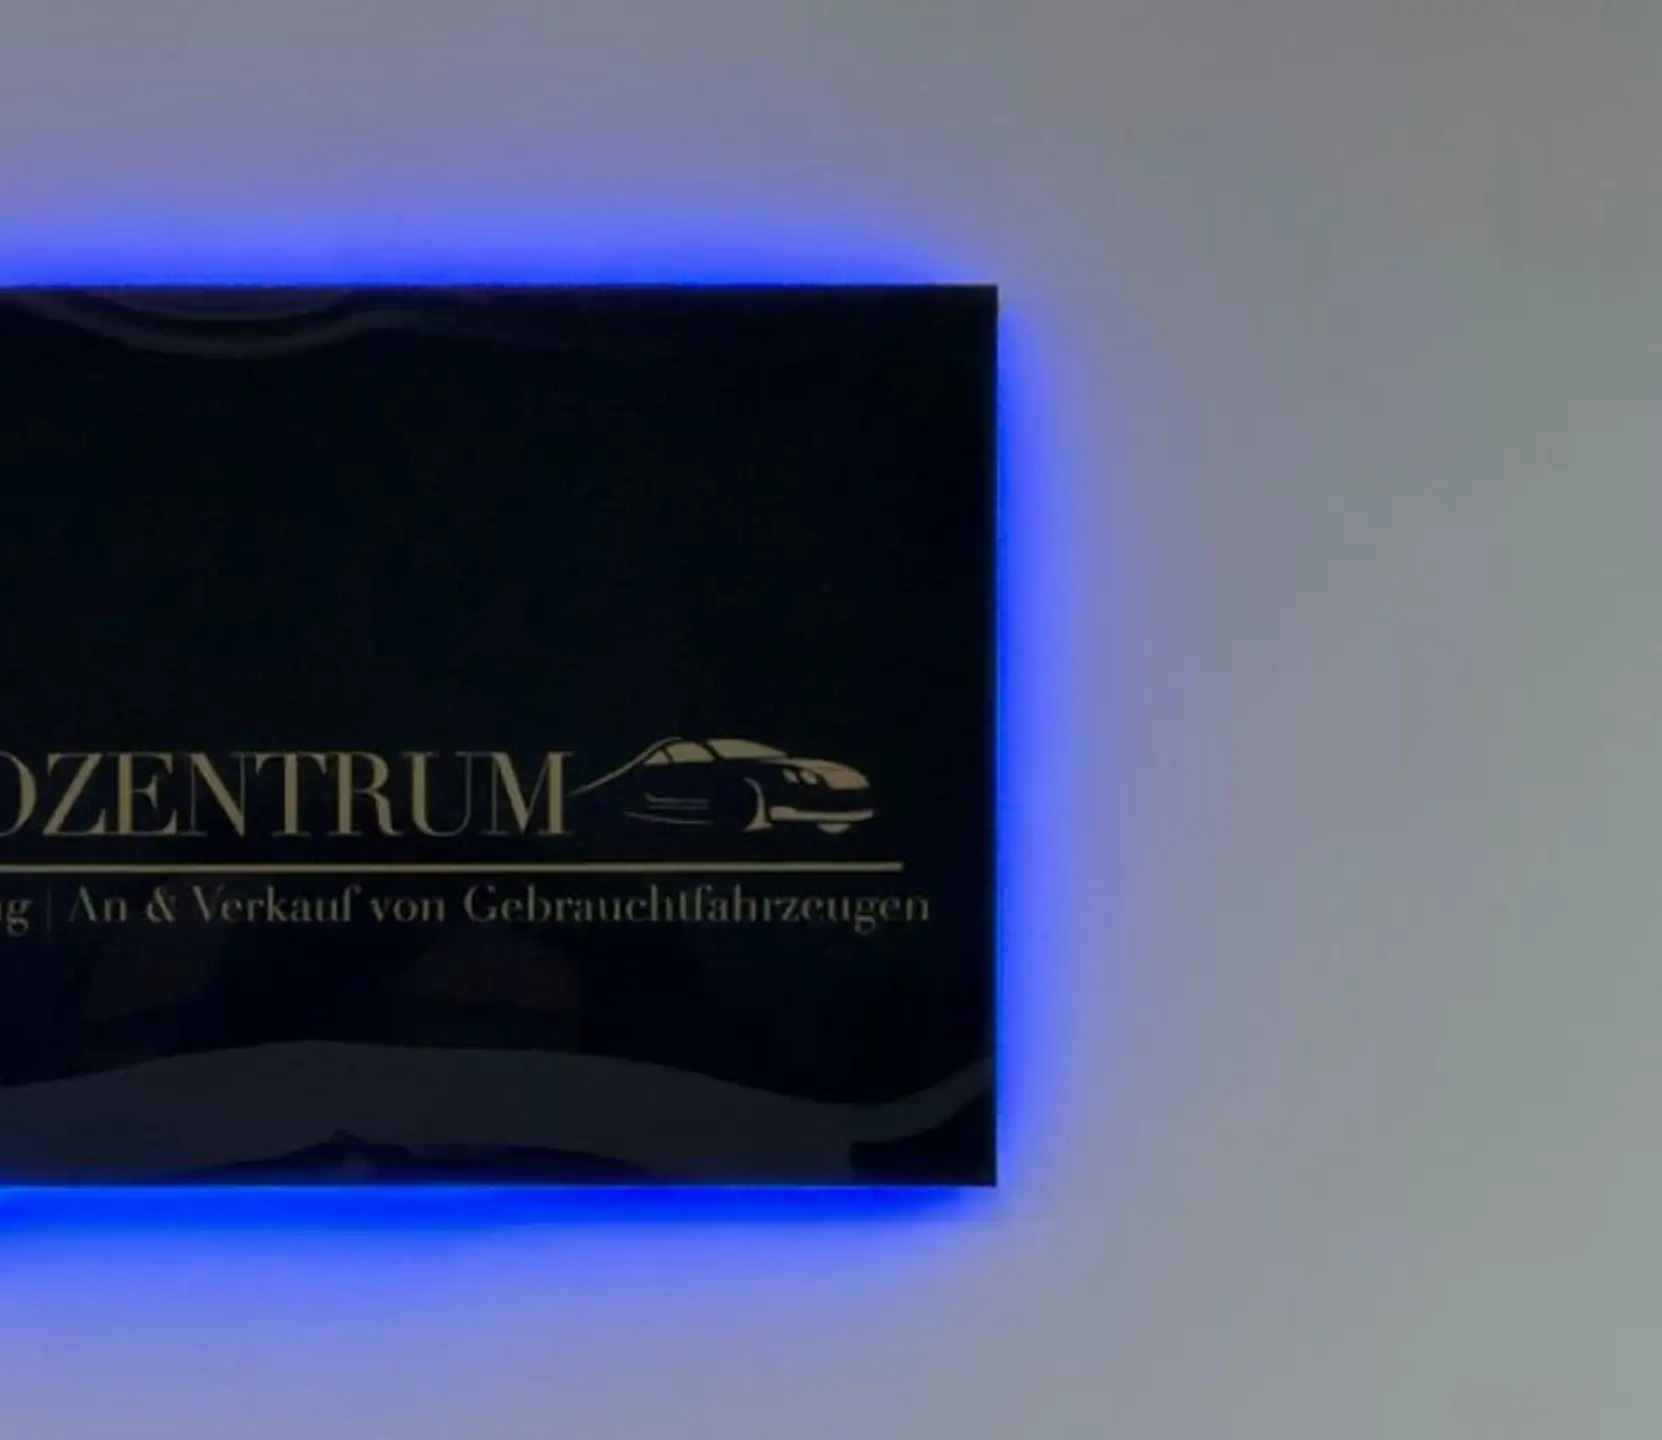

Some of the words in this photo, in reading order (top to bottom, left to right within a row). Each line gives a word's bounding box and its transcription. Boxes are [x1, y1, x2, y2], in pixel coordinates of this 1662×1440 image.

[67, 886, 129, 924] An
[146, 886, 177, 924] &
[192, 884, 362, 924] Verkauf
[369, 895, 446, 923] von
[463, 884, 930, 936] Gebrauchtfahrzeugen
